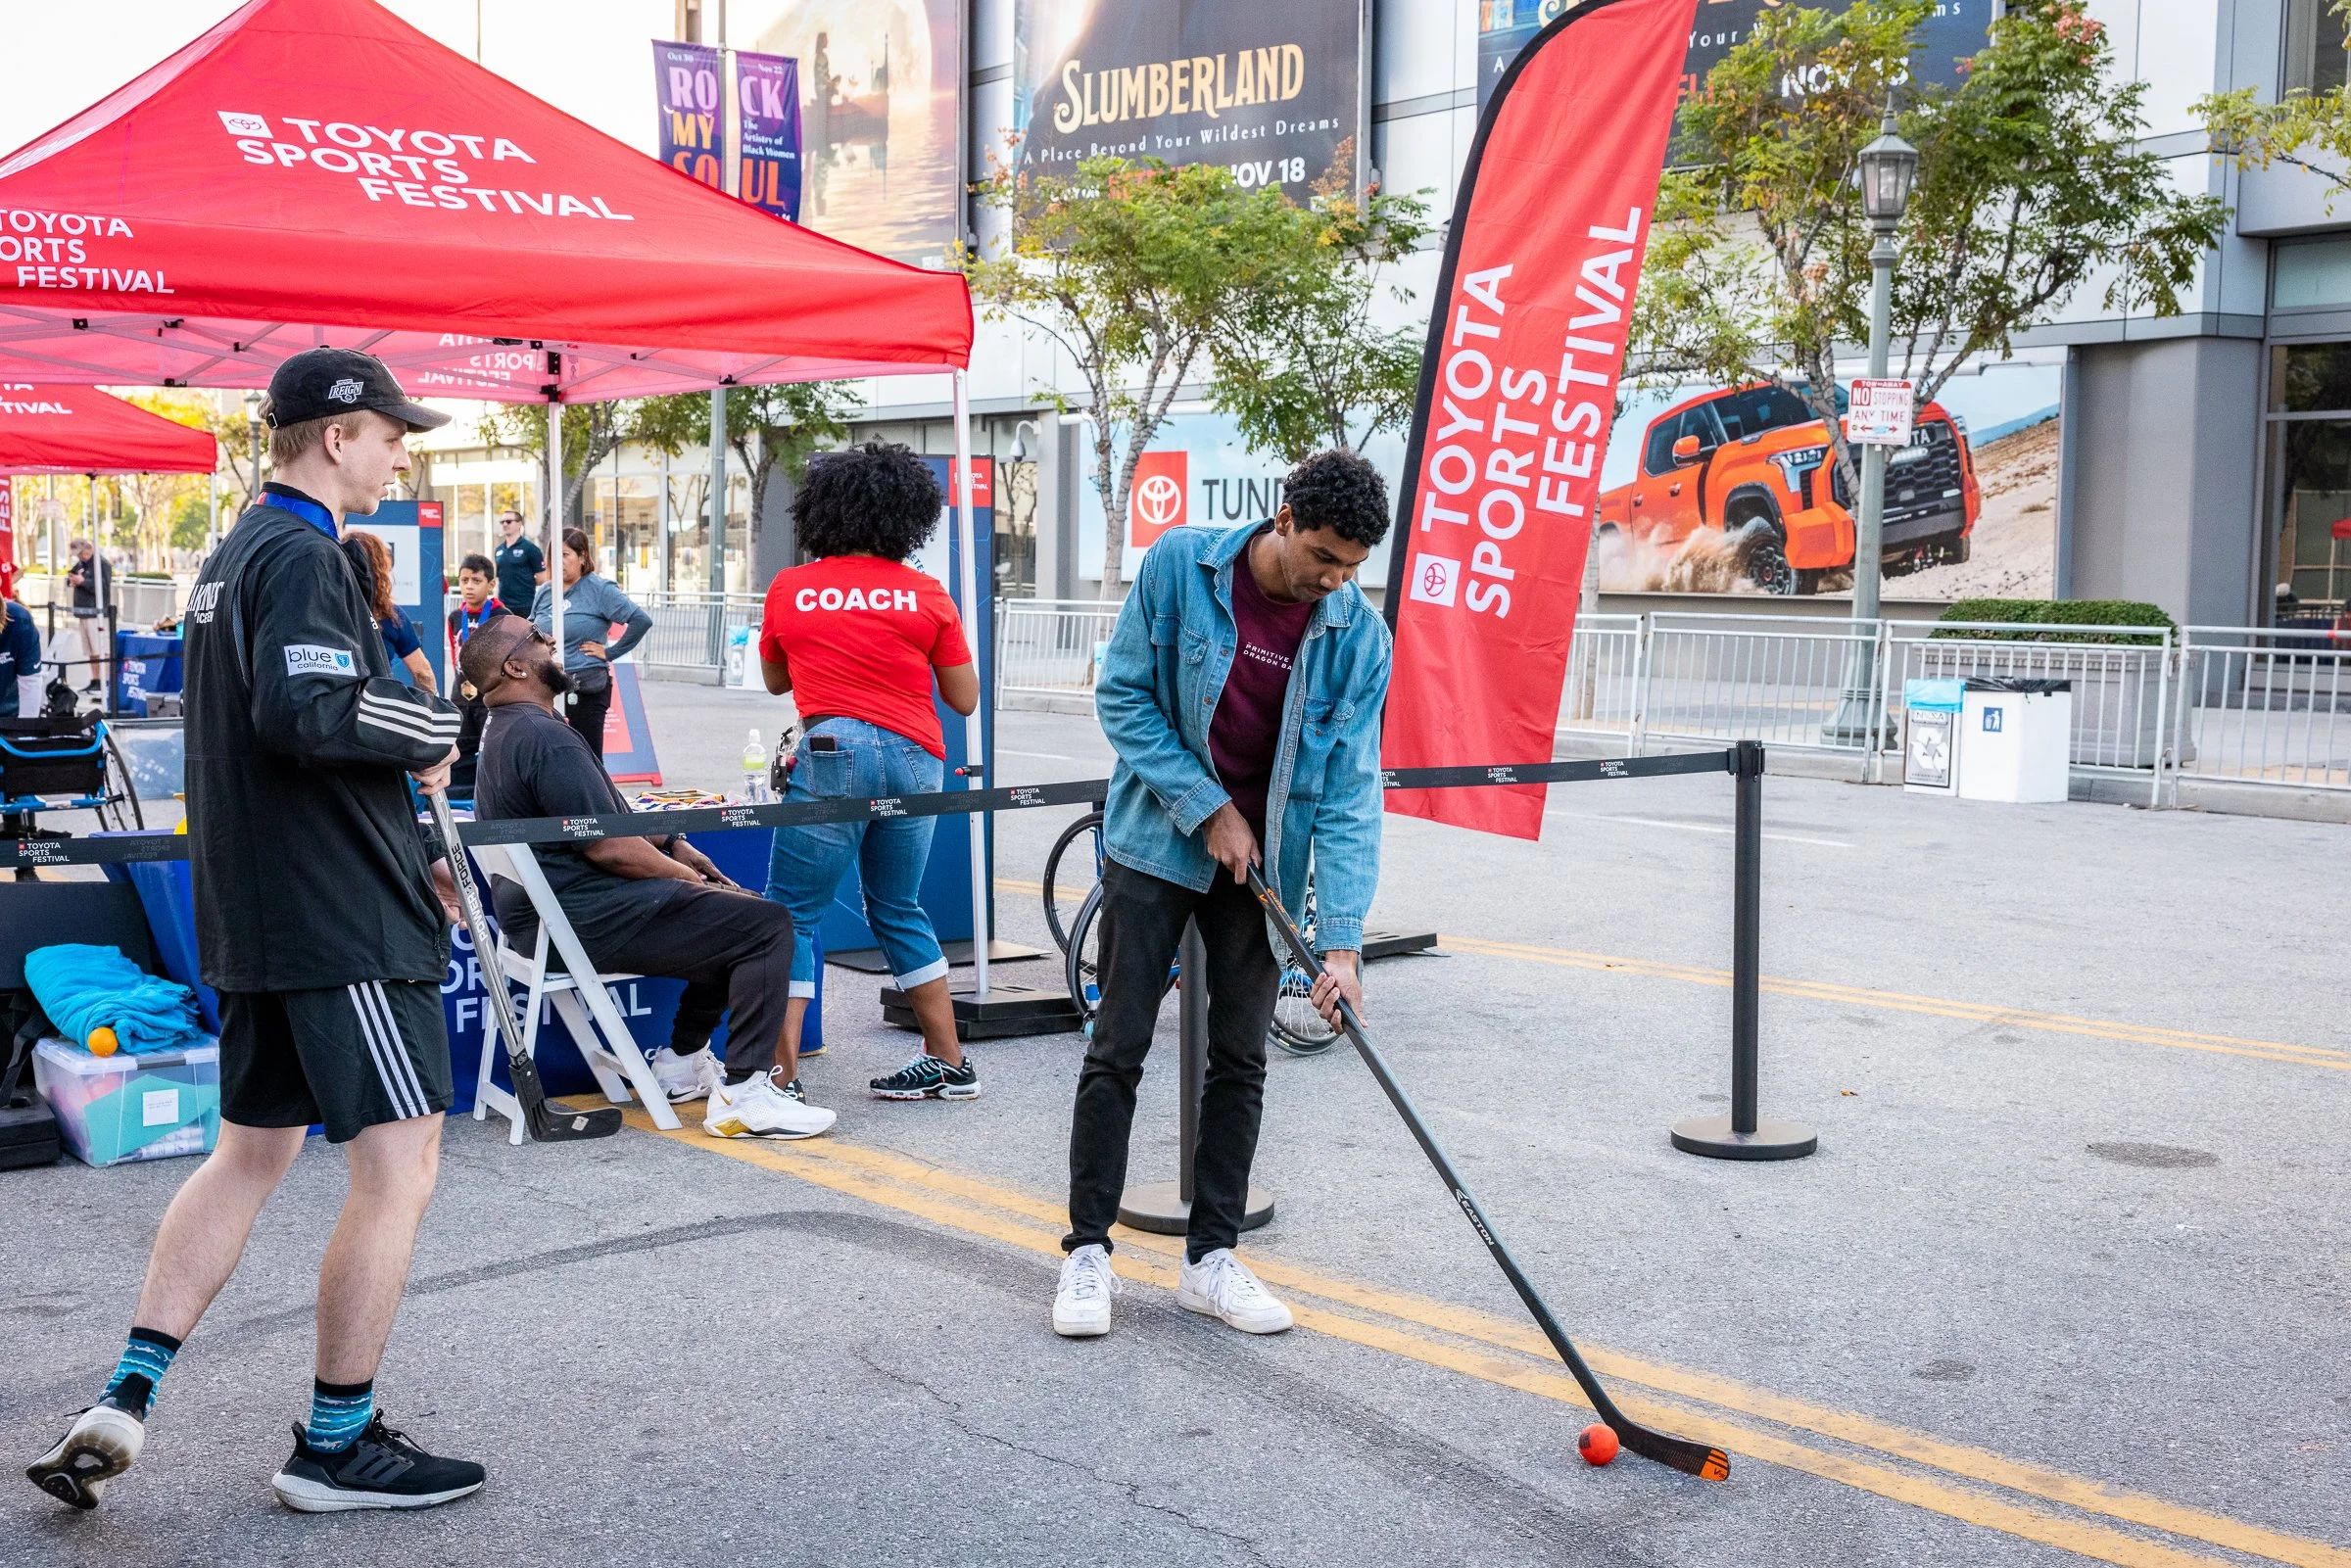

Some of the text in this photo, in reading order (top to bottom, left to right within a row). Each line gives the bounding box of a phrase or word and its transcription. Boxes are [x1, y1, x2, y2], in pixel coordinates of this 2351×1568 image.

[1688, 29, 1739, 49] Your
[1493, 56, 1505, 73] A
[1054, 44, 1305, 134] SLUMBERLAND
[282, 117, 537, 164] TOYOTA
[673, 111, 715, 150] MY
[744, 132, 784, 146] Artistry of
[1024, 118, 1339, 165] A Place Beyond Your Wildest Dreams
[236, 139, 469, 184] SPORTS
[743, 144, 795, 159] Black Women
[1277, 157, 1306, 184] 18
[358, 177, 635, 221] FESTIVAL
[0, 236, 86, 263] ORTS
[17, 265, 174, 294] FESTIVAL
[1536, 207, 1641, 517] FESTIVAL
[333, 384, 360, 396] REIGN
[1420, 263, 1513, 533] TOYOTA
[1852, 388, 1908, 405] NO STOPPING
[0, 402, 73, 414] TIVAL
[1854, 409, 1904, 422] ANY TIME
[1202, 478, 1285, 521] TUN
[1464, 366, 1547, 619] SPORTS
[795, 588, 918, 612] COACH
[288, 648, 332, 663] blue
[298, 661, 338, 671] california
[1243, 649, 1278, 666] DRAGON
[1245, 643, 1290, 663] PRIMITIVE
[452, 842, 471, 888] FORCE
[466, 887, 489, 942] POWER
[1462, 1200, 1495, 1246] EASTON
